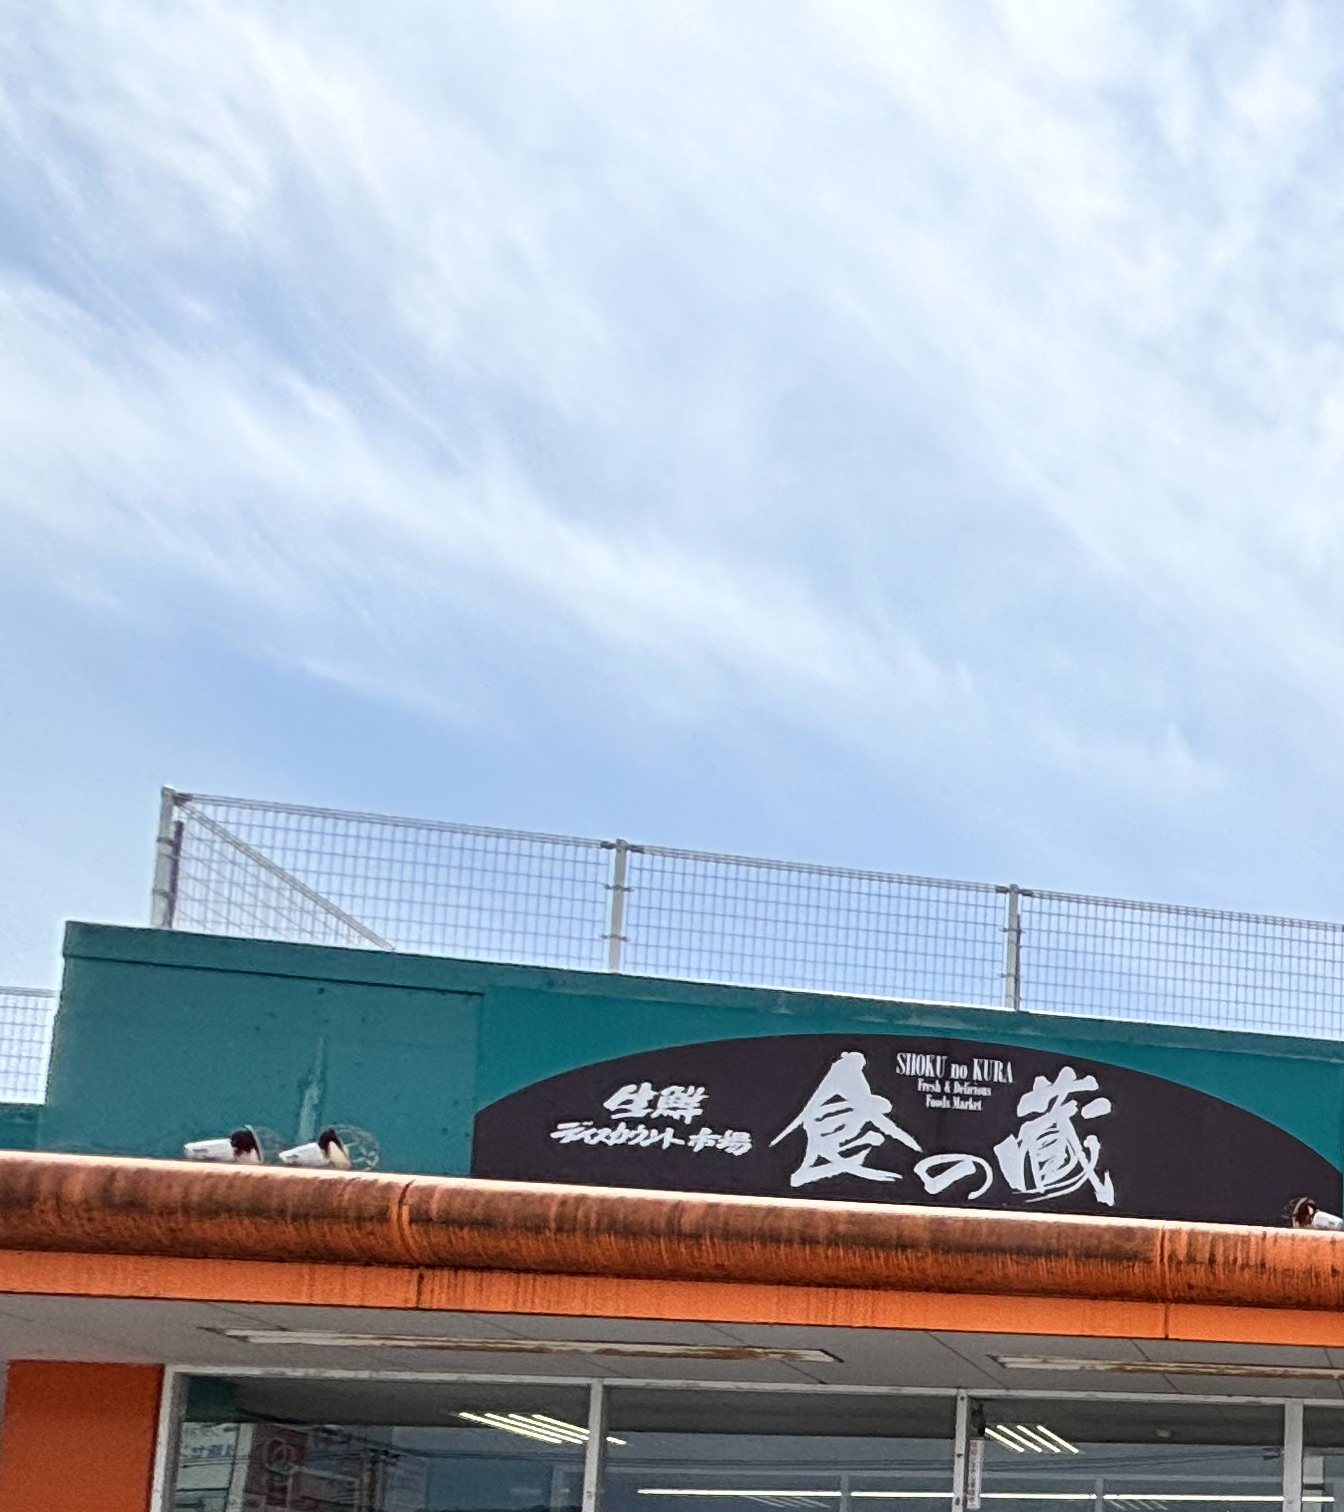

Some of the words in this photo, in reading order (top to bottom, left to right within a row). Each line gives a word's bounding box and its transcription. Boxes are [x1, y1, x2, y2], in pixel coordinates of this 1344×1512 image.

[896, 1052, 947, 1078] SHOKU
[950, 1064, 968, 1079] no
[973, 1058, 1013, 1083] KURA
[603, 1082, 709, 1124] 生鮮
[917, 1078, 941, 1093] Fresh
[944, 1081, 951, 1093] &
[953, 1081, 991, 1096] Delicious
[925, 1094, 951, 1109] Foods
[952, 1096, 982, 1111] Market
[550, 1121, 752, 1156] ディスカウント市場
[769, 1051, 1115, 1206] 食の蔵
